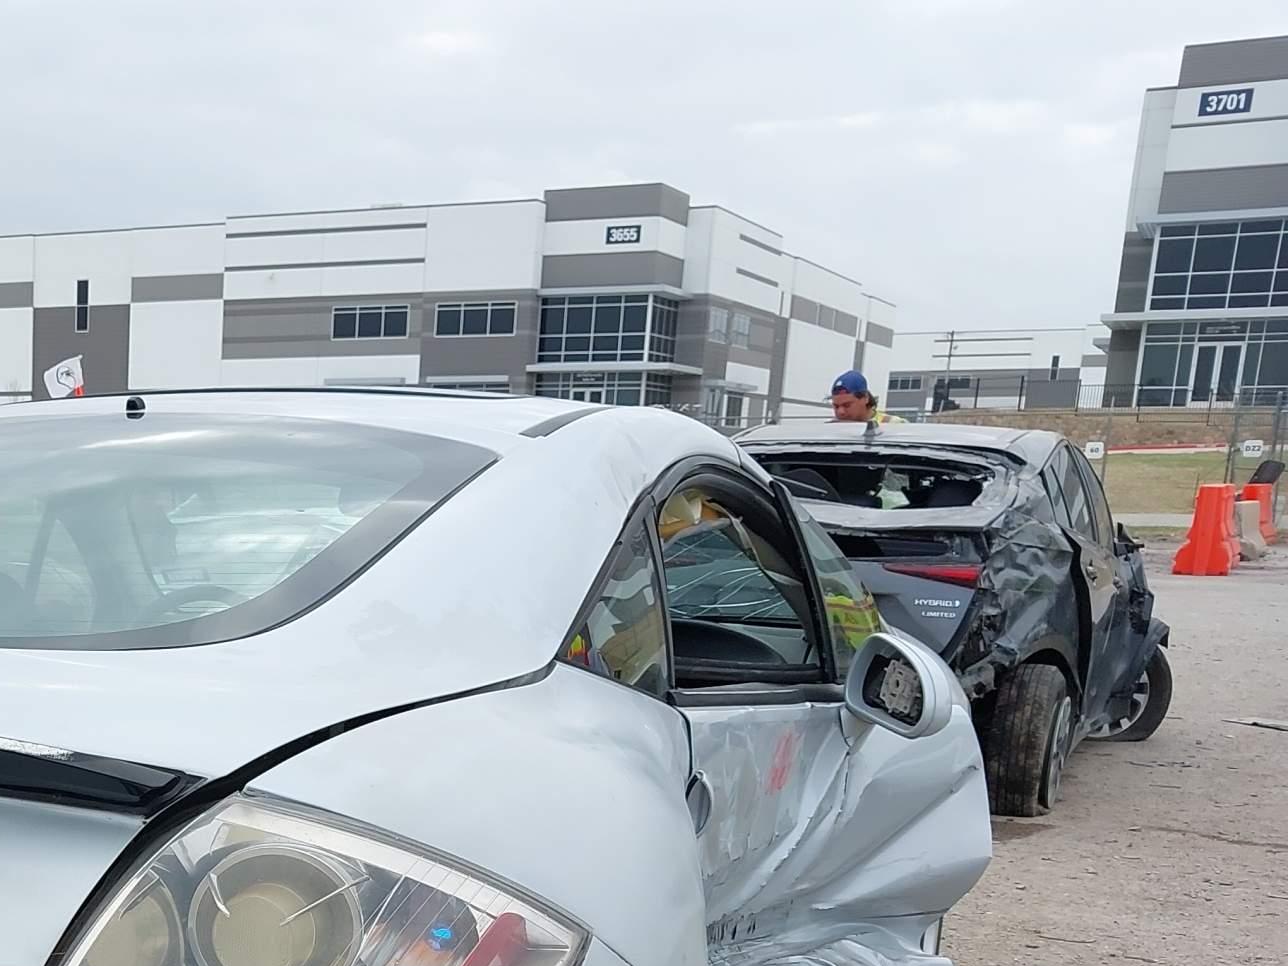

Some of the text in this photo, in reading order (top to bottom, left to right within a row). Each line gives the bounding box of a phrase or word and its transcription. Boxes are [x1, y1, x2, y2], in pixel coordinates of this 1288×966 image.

[1205, 92, 1247, 112] 3701
[608, 227, 639, 242] 3655
[914, 598, 953, 607] HYBRID
